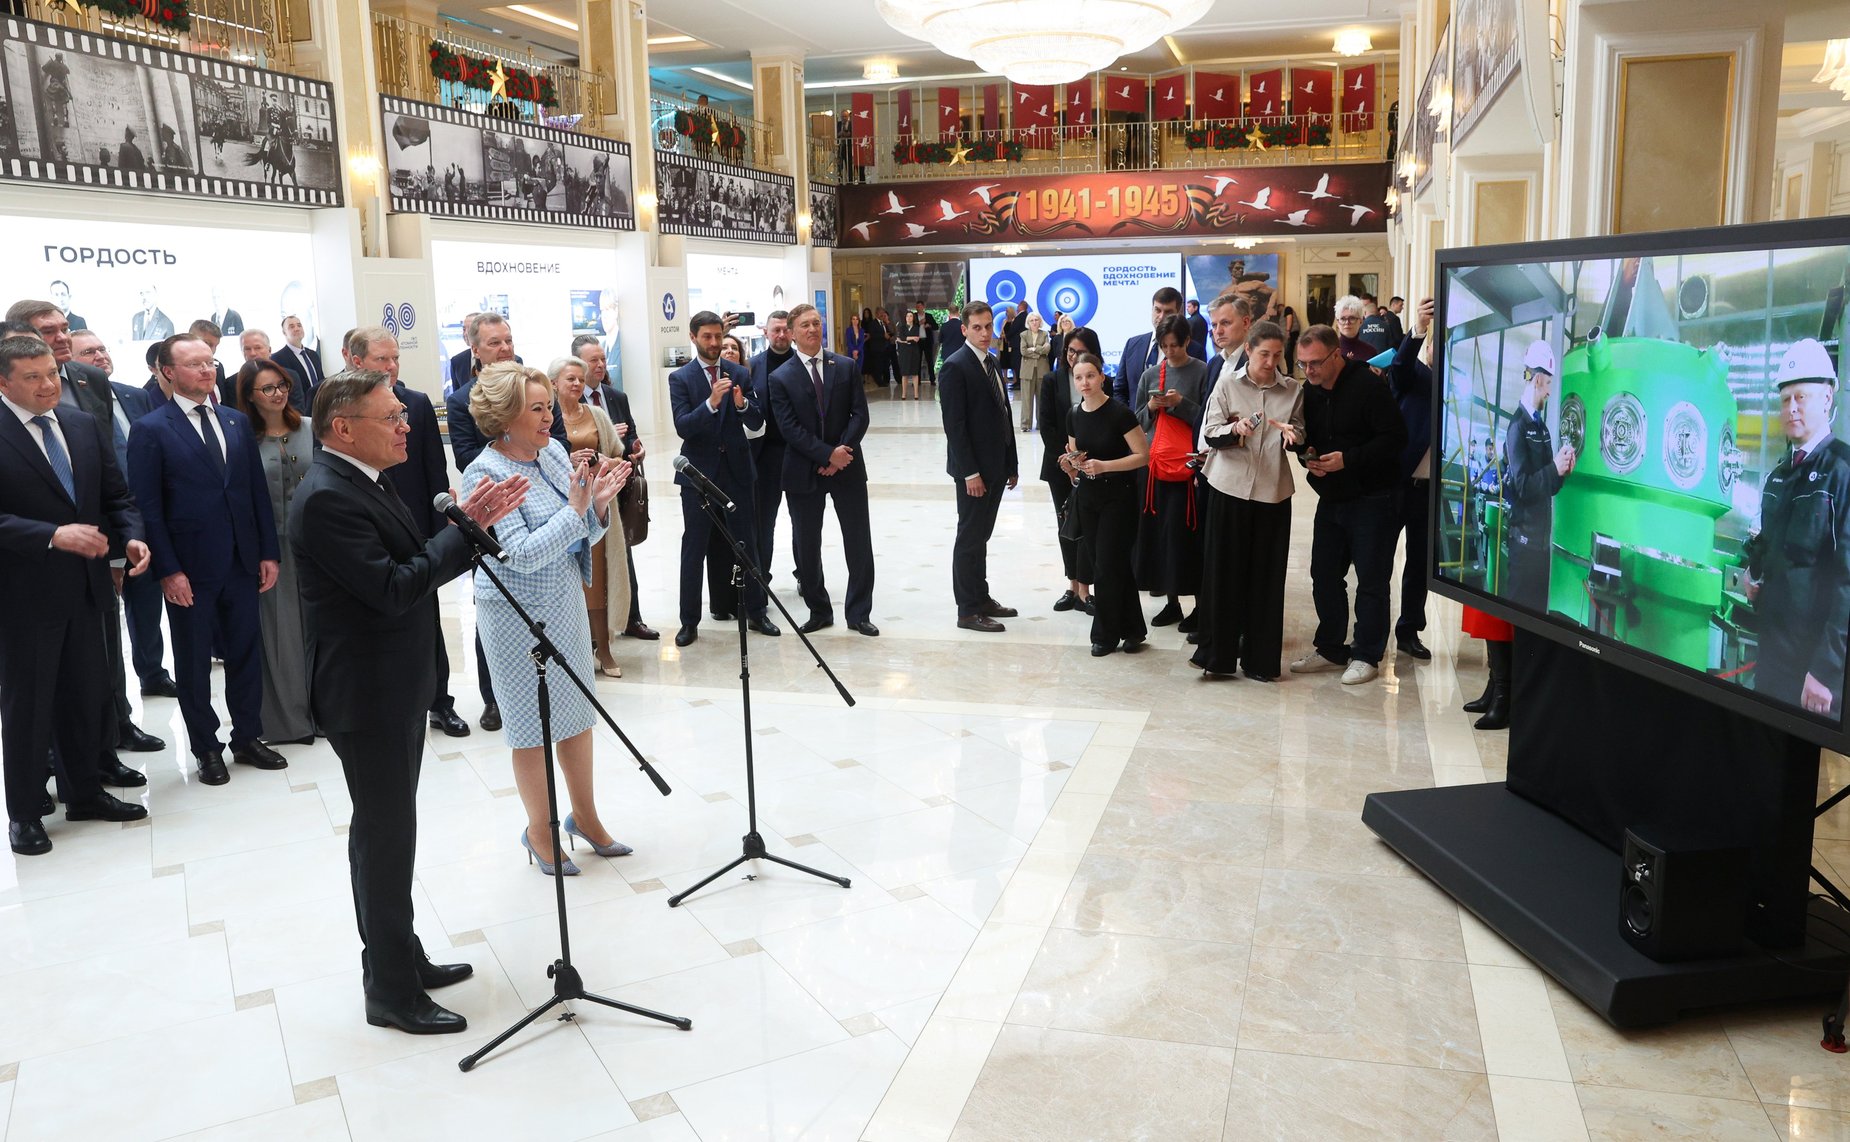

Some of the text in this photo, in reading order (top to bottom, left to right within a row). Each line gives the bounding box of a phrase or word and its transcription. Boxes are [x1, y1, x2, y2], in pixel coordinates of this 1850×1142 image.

[1025, 184, 1180, 220] 1941-1945
[44, 245, 177, 268] ГОРДОСТЬ
[477, 261, 560, 275] ВДОХНОВЕНИЕ
[1103, 265, 1157, 273] ГОРДОСТЬ
[1103, 272, 1176, 280] ВДОХНОВЕНИЕ
[660, 325, 680, 333] РОСАТОМ
[1578, 640, 1601, 655] Panasonic
